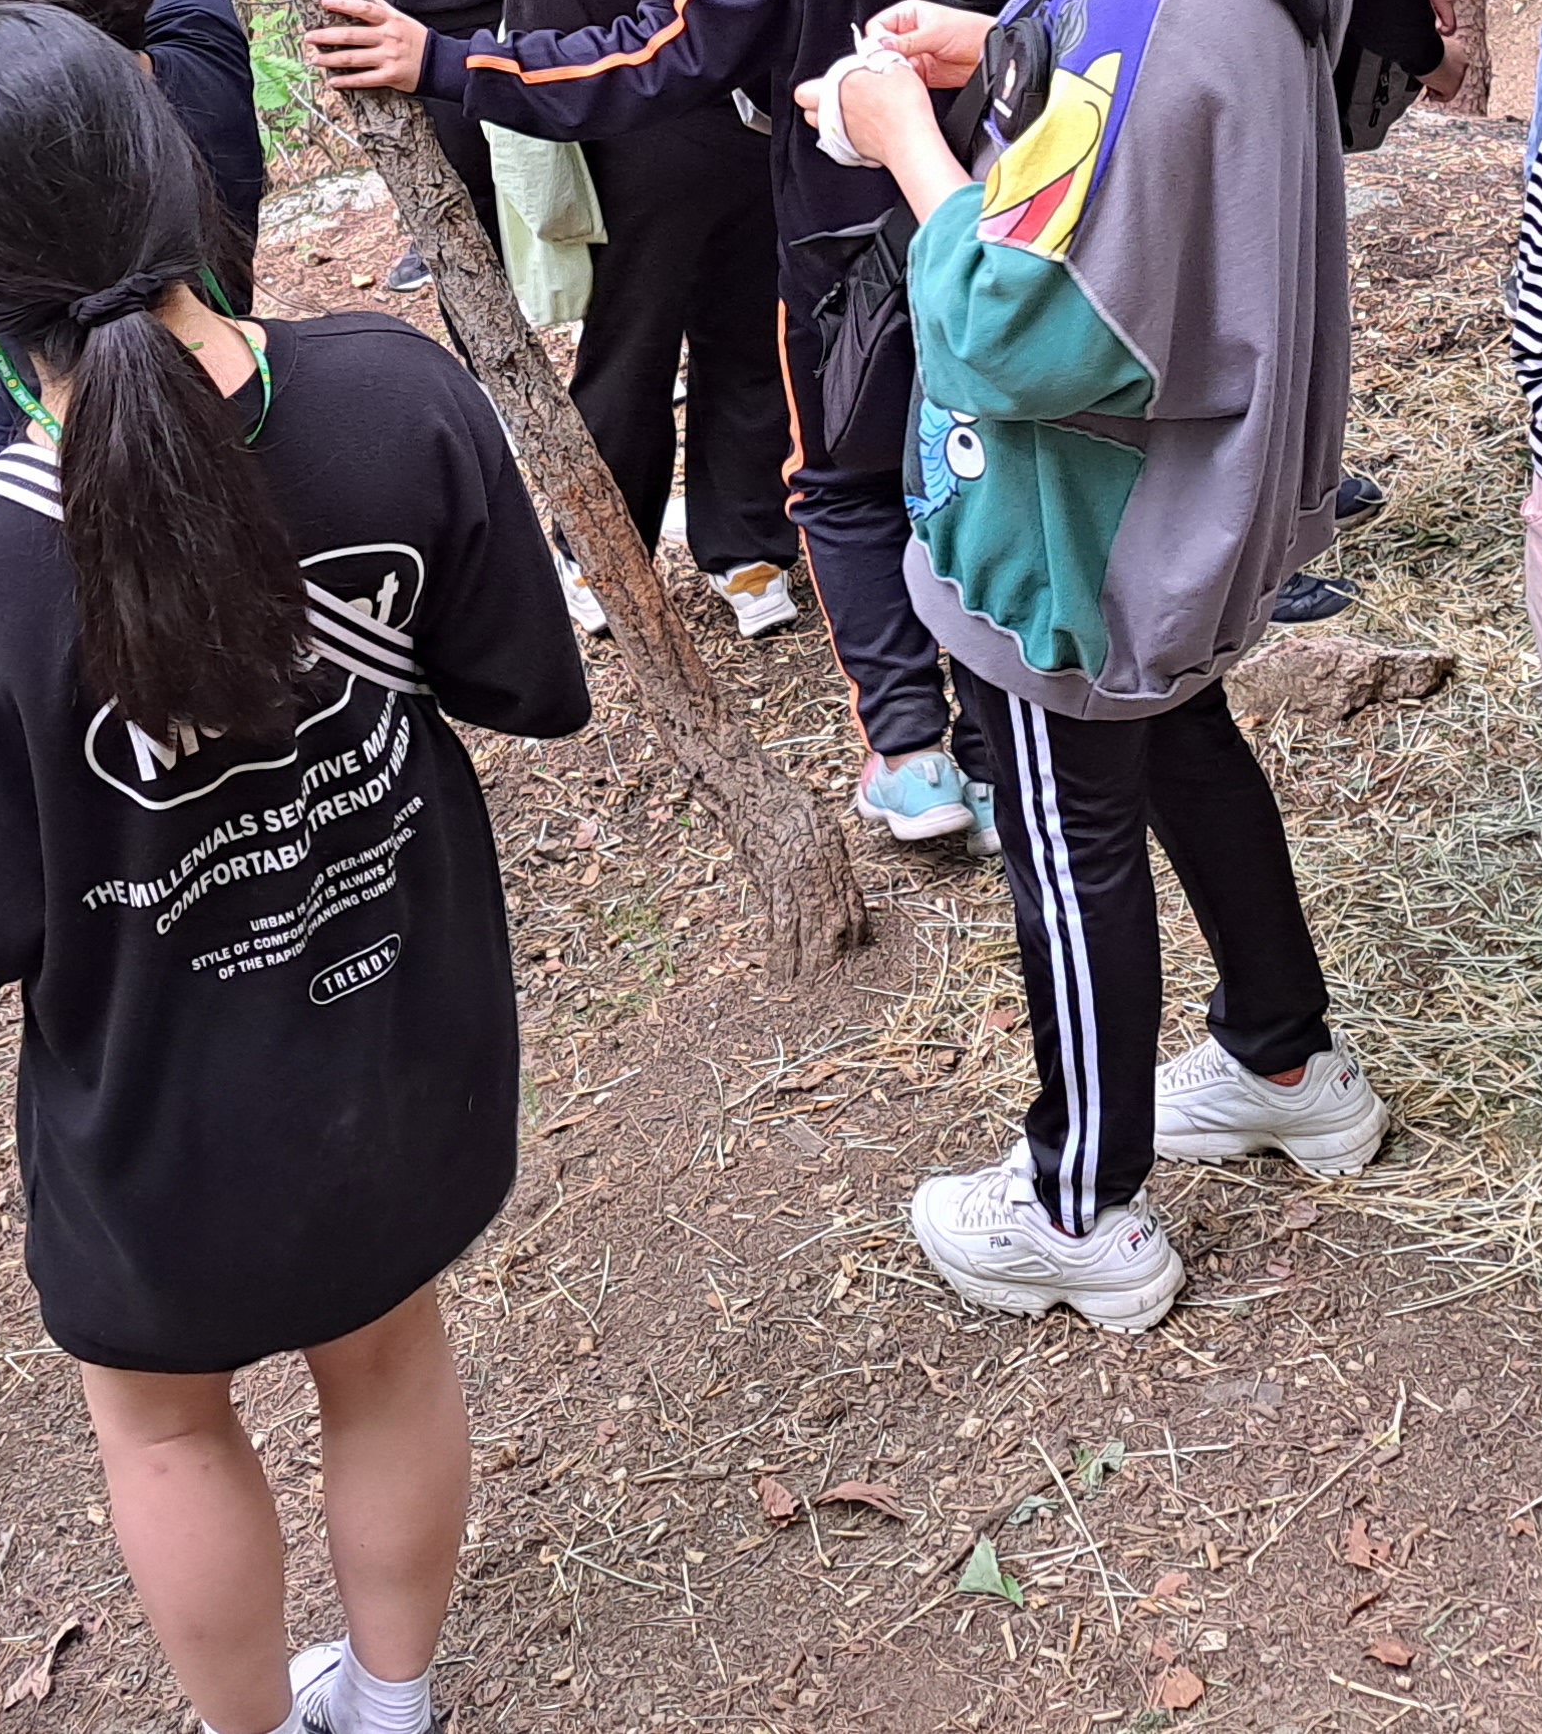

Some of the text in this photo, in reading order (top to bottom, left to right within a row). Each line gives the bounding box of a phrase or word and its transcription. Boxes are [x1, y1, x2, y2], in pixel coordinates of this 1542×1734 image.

[307, 765, 392, 832] TRENDY
[81, 880, 128, 911] THE
[128, 813, 258, 909] MILLENIALS
[191, 947, 232, 971] STYLE
[233, 939, 250, 956] OF
[324, 885, 337, 900] IS
[339, 864, 386, 892] ALWAYS
[249, 910, 295, 932] URBAN
[218, 967, 236, 981] OF
[238, 956, 265, 974] THE
[989, 1235, 1012, 1249] FILA
[1127, 1215, 1158, 1252] FILA
